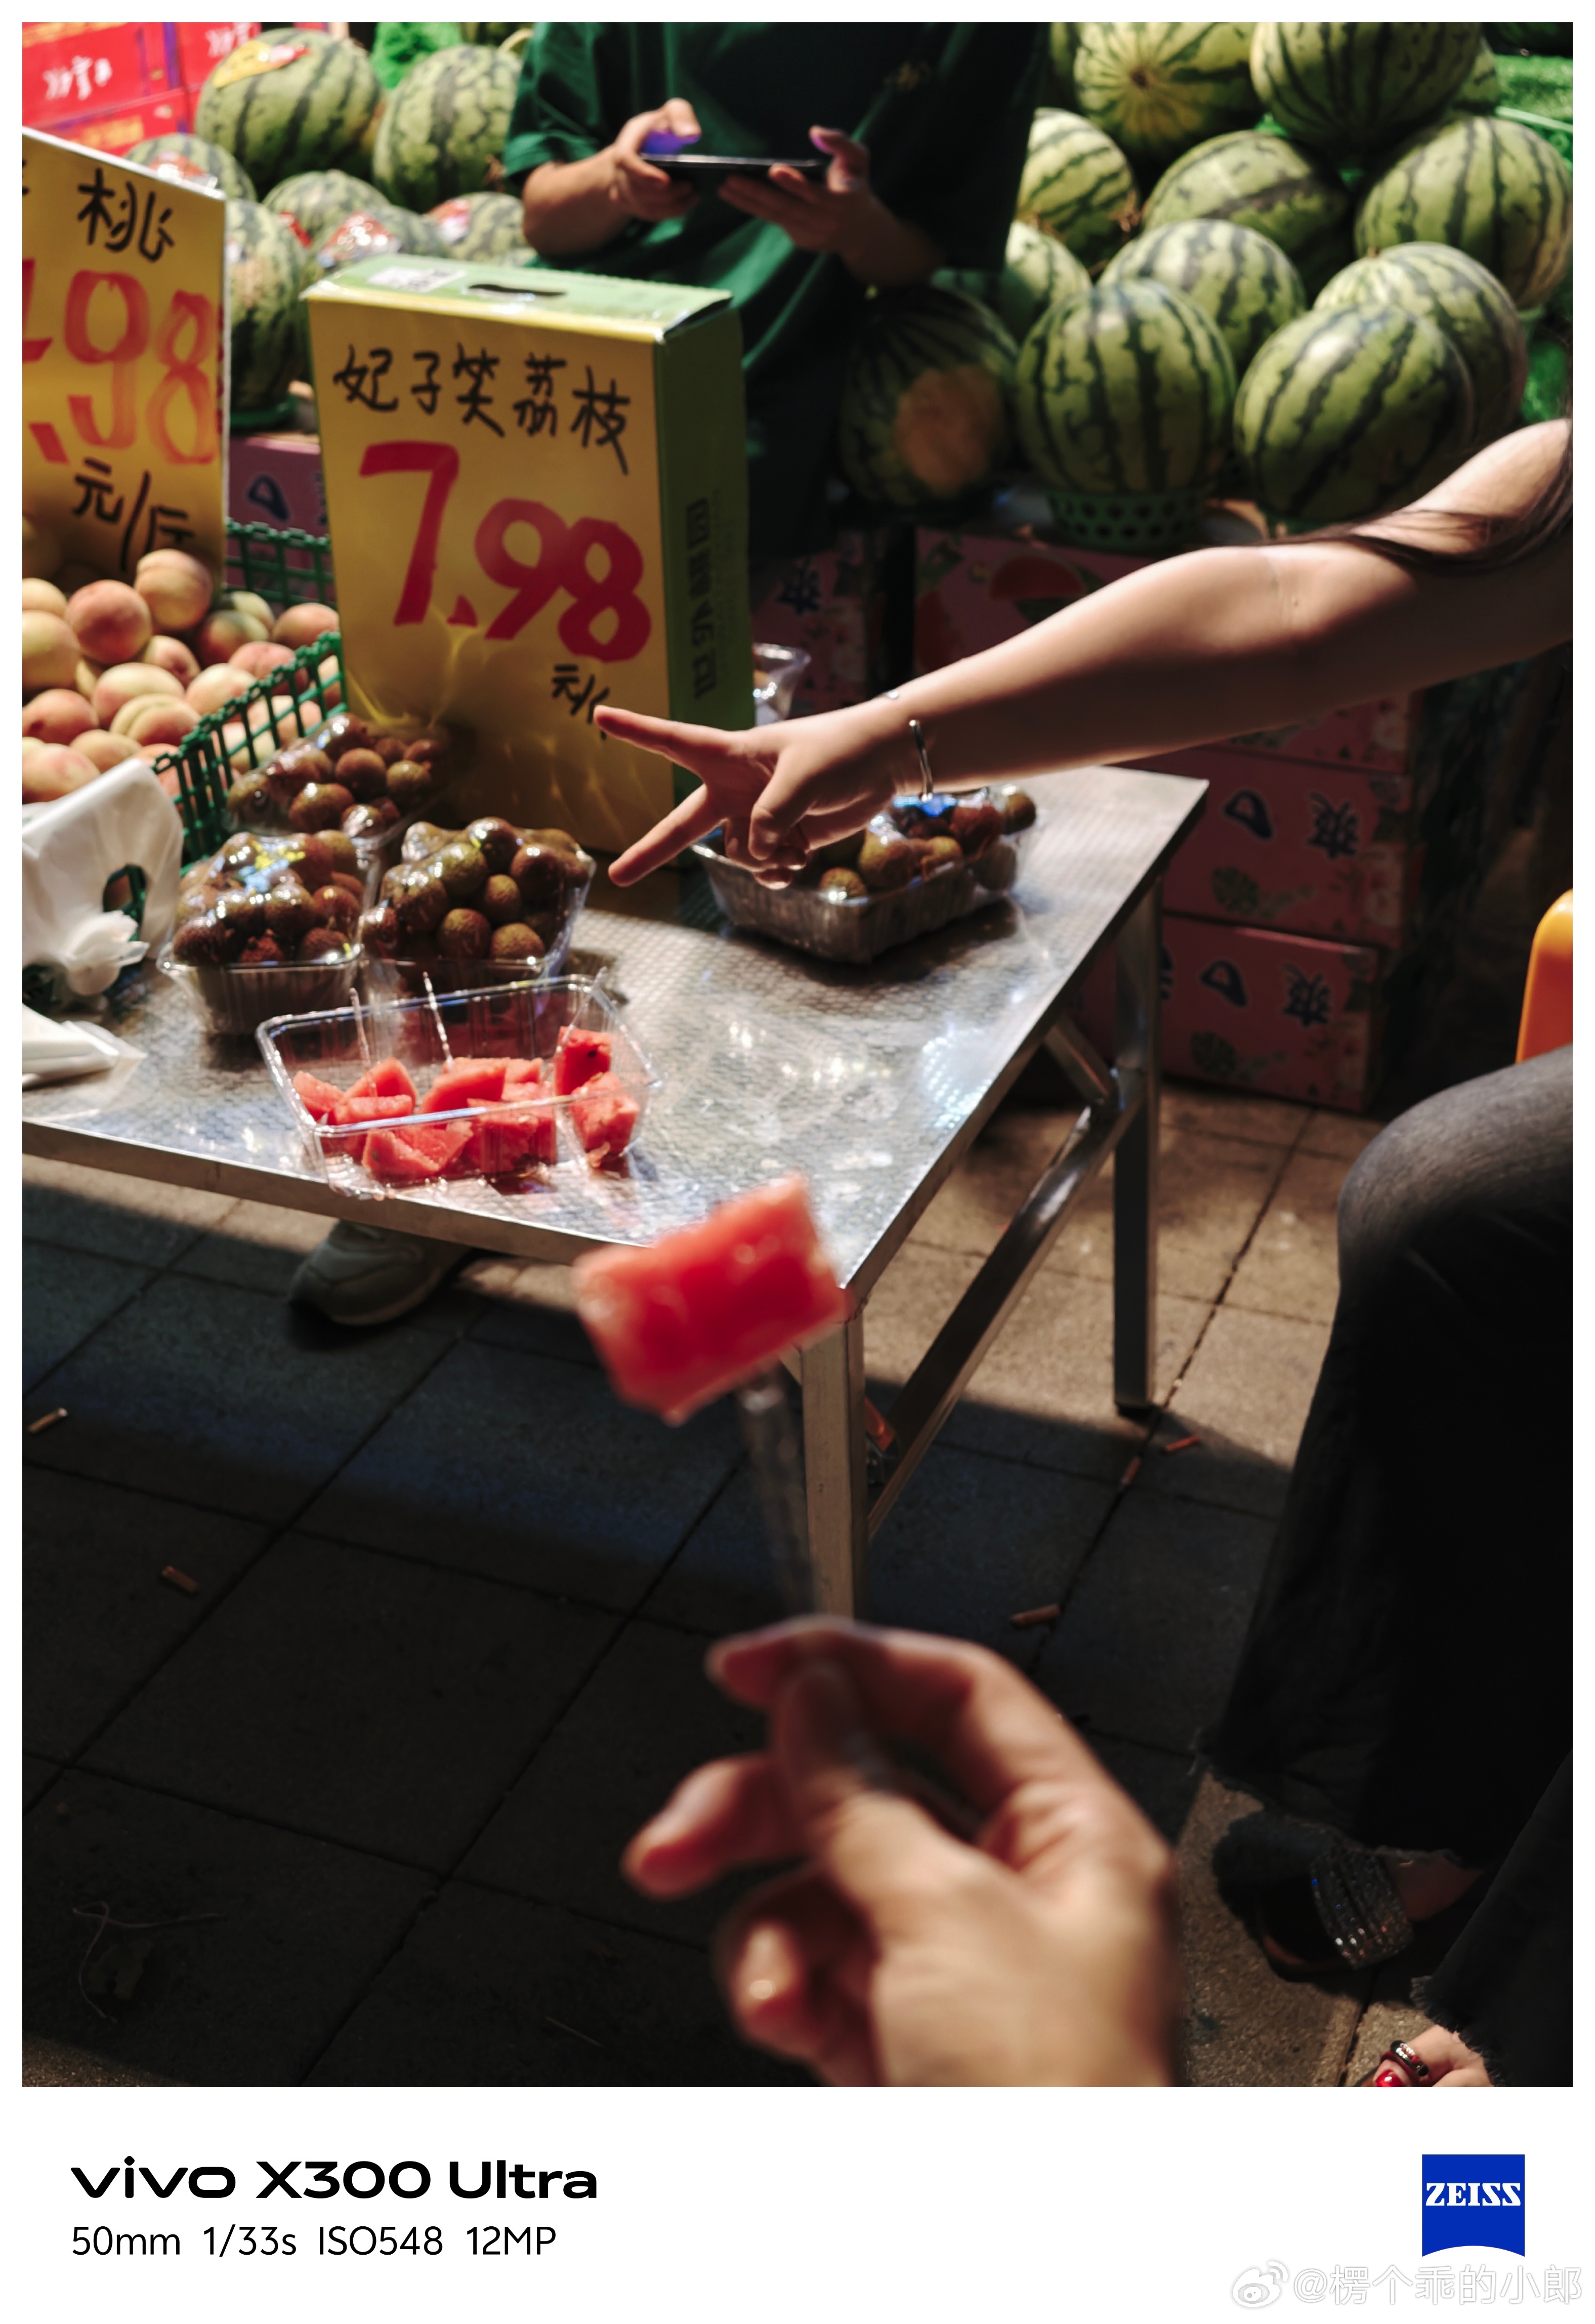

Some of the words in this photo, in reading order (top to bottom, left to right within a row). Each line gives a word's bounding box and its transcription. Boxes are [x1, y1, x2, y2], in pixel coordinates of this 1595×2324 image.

[22, 160, 175, 262] 桃
[332, 343, 631, 475] 妃子笑荔枝
[359, 440, 652, 663] 7.98
[1162, 943, 1332, 1028] 爽口
